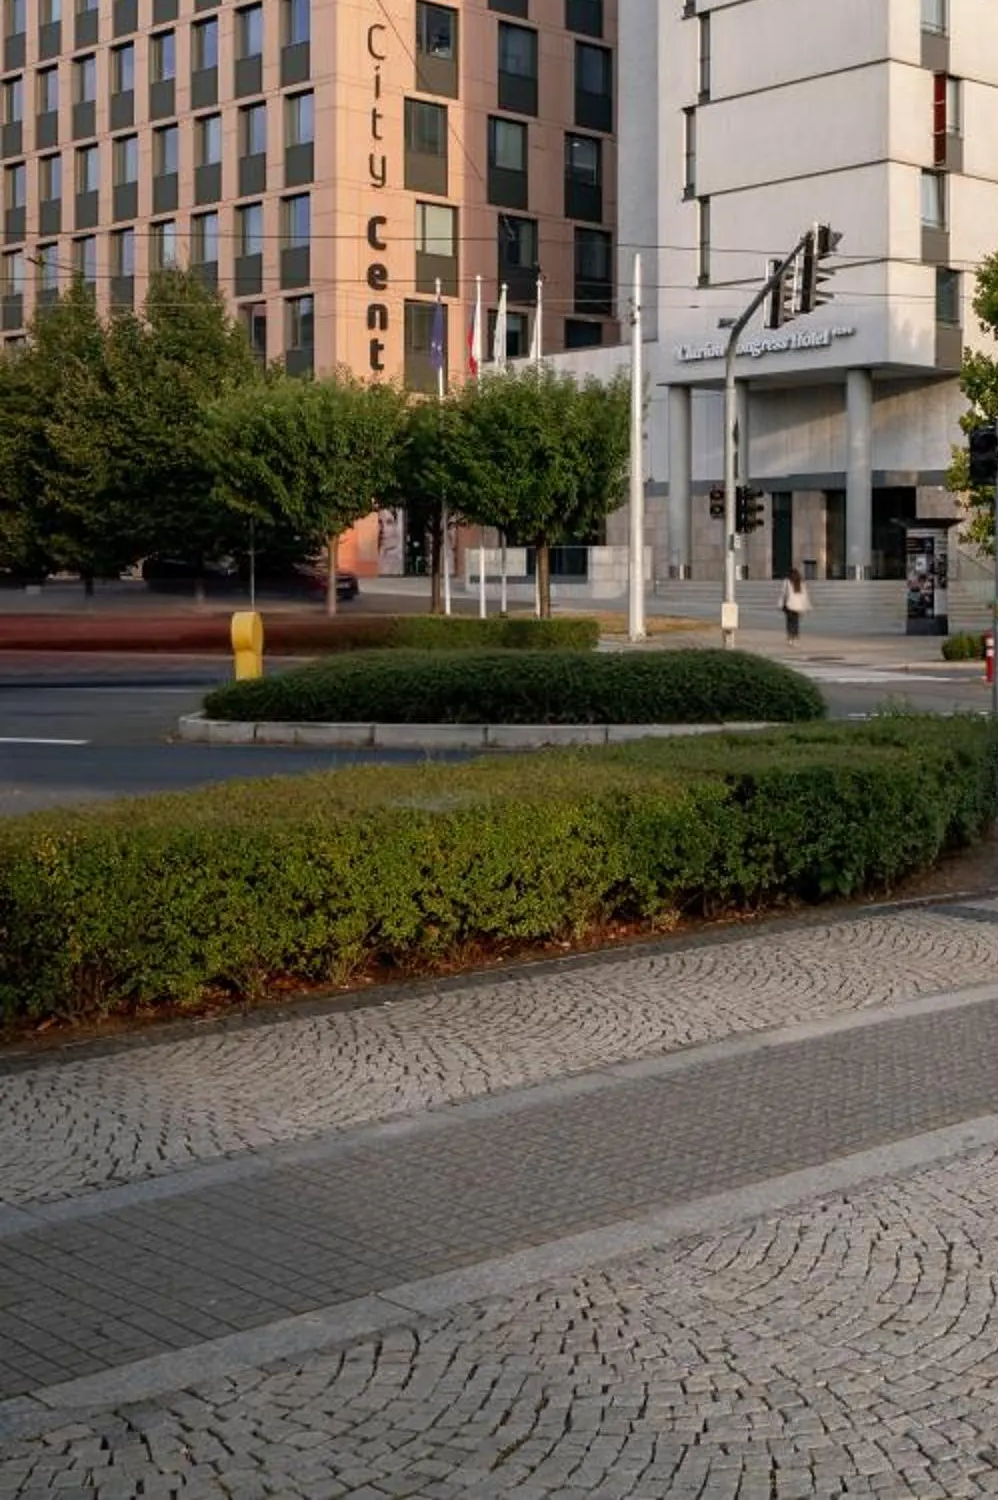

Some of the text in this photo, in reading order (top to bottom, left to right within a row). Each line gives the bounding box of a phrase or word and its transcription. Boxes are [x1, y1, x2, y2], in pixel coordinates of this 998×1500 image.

[367, 24, 387, 188] City
[735, 336, 788, 357] ongress
[790, 328, 829, 349] Hotel
